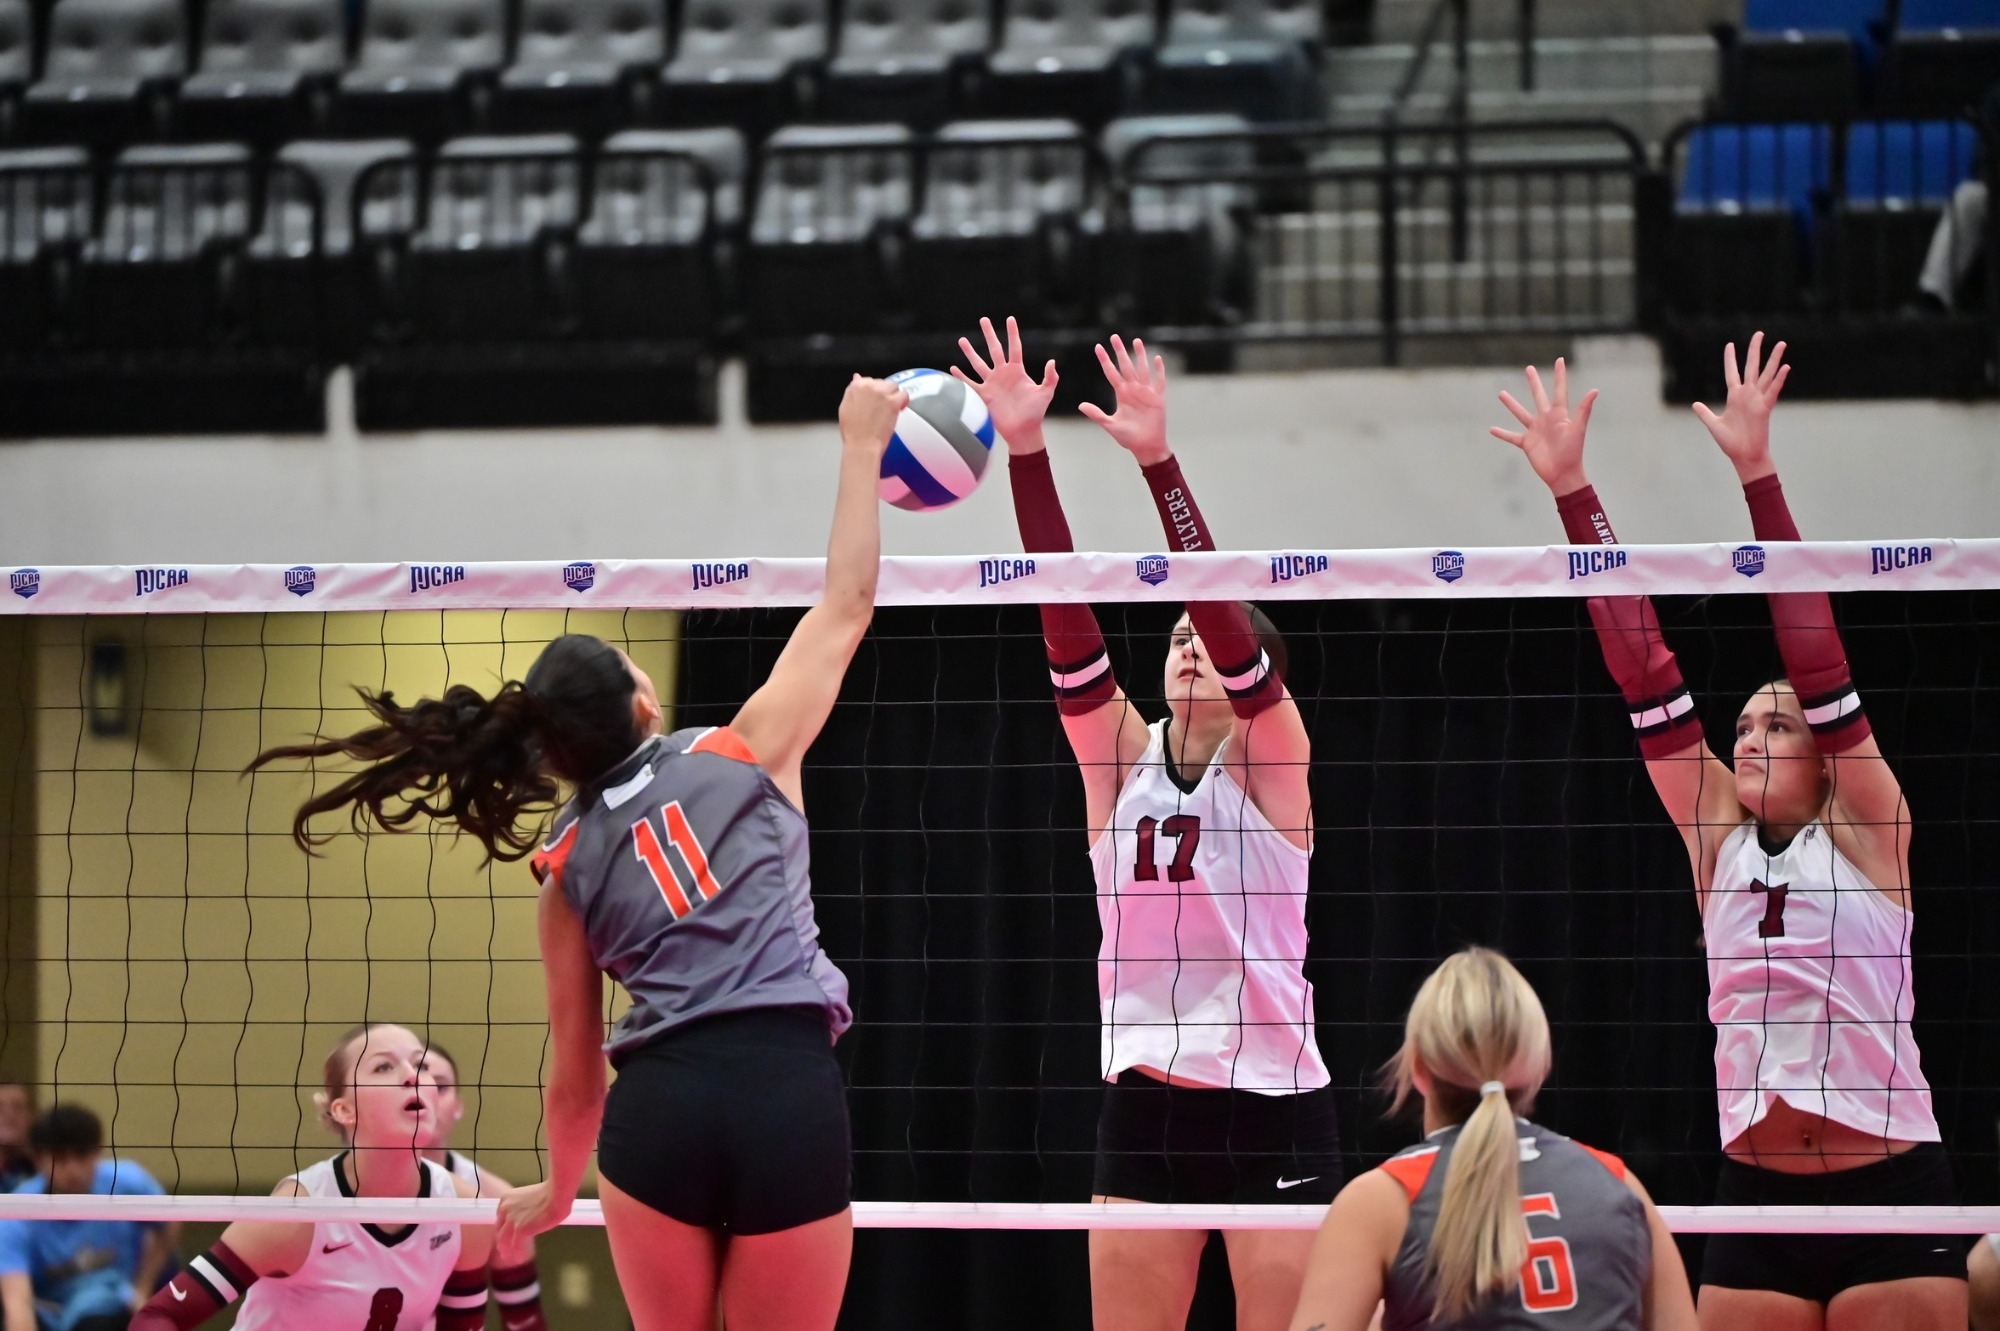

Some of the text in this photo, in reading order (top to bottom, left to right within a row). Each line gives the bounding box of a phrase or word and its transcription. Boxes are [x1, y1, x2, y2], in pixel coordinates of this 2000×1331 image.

[1164, 487, 1202, 552] FLYERS
[1135, 559, 1169, 577] NJCAA
[1271, 555, 1328, 584] NJCAA
[1432, 556, 1465, 573] NJCAA
[1567, 550, 1627, 580] NJCAA
[1732, 550, 1766, 568] NJCAA
[1871, 546, 1932, 575] NJCAA
[9, 573, 40, 589] NJCAA
[135, 569, 189, 597] NJCAA
[284, 571, 316, 587] NJCAA
[410, 566, 465, 594] NJCAA
[562, 566, 595, 583] NJCAA
[691, 563, 749, 591] NJCAA
[979, 559, 1036, 588] NJCAA
[631, 799, 721, 921] 11
[1134, 814, 1201, 882] 17
[1517, 1191, 1578, 1313] 6
